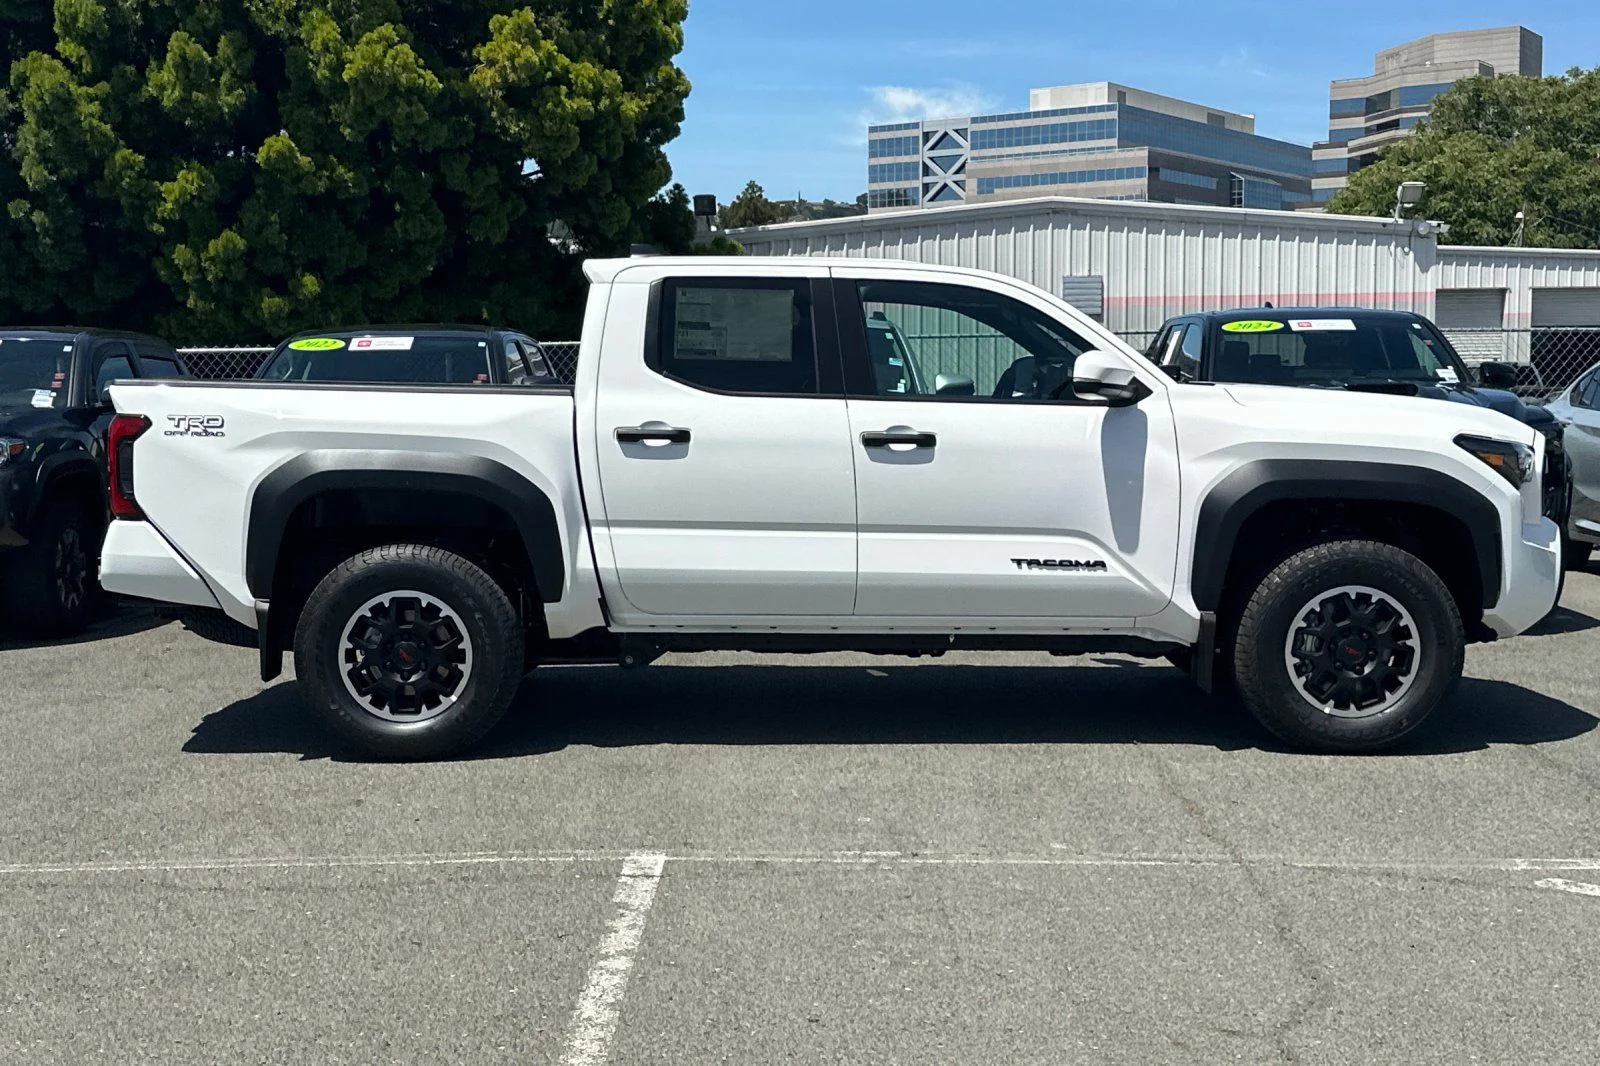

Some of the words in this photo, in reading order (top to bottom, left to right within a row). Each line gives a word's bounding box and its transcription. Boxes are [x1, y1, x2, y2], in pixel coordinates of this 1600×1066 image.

[1231, 322, 1275, 331] 2024
[167, 414, 225, 431] TRD
[1010, 558, 1107, 570] TACOMA
